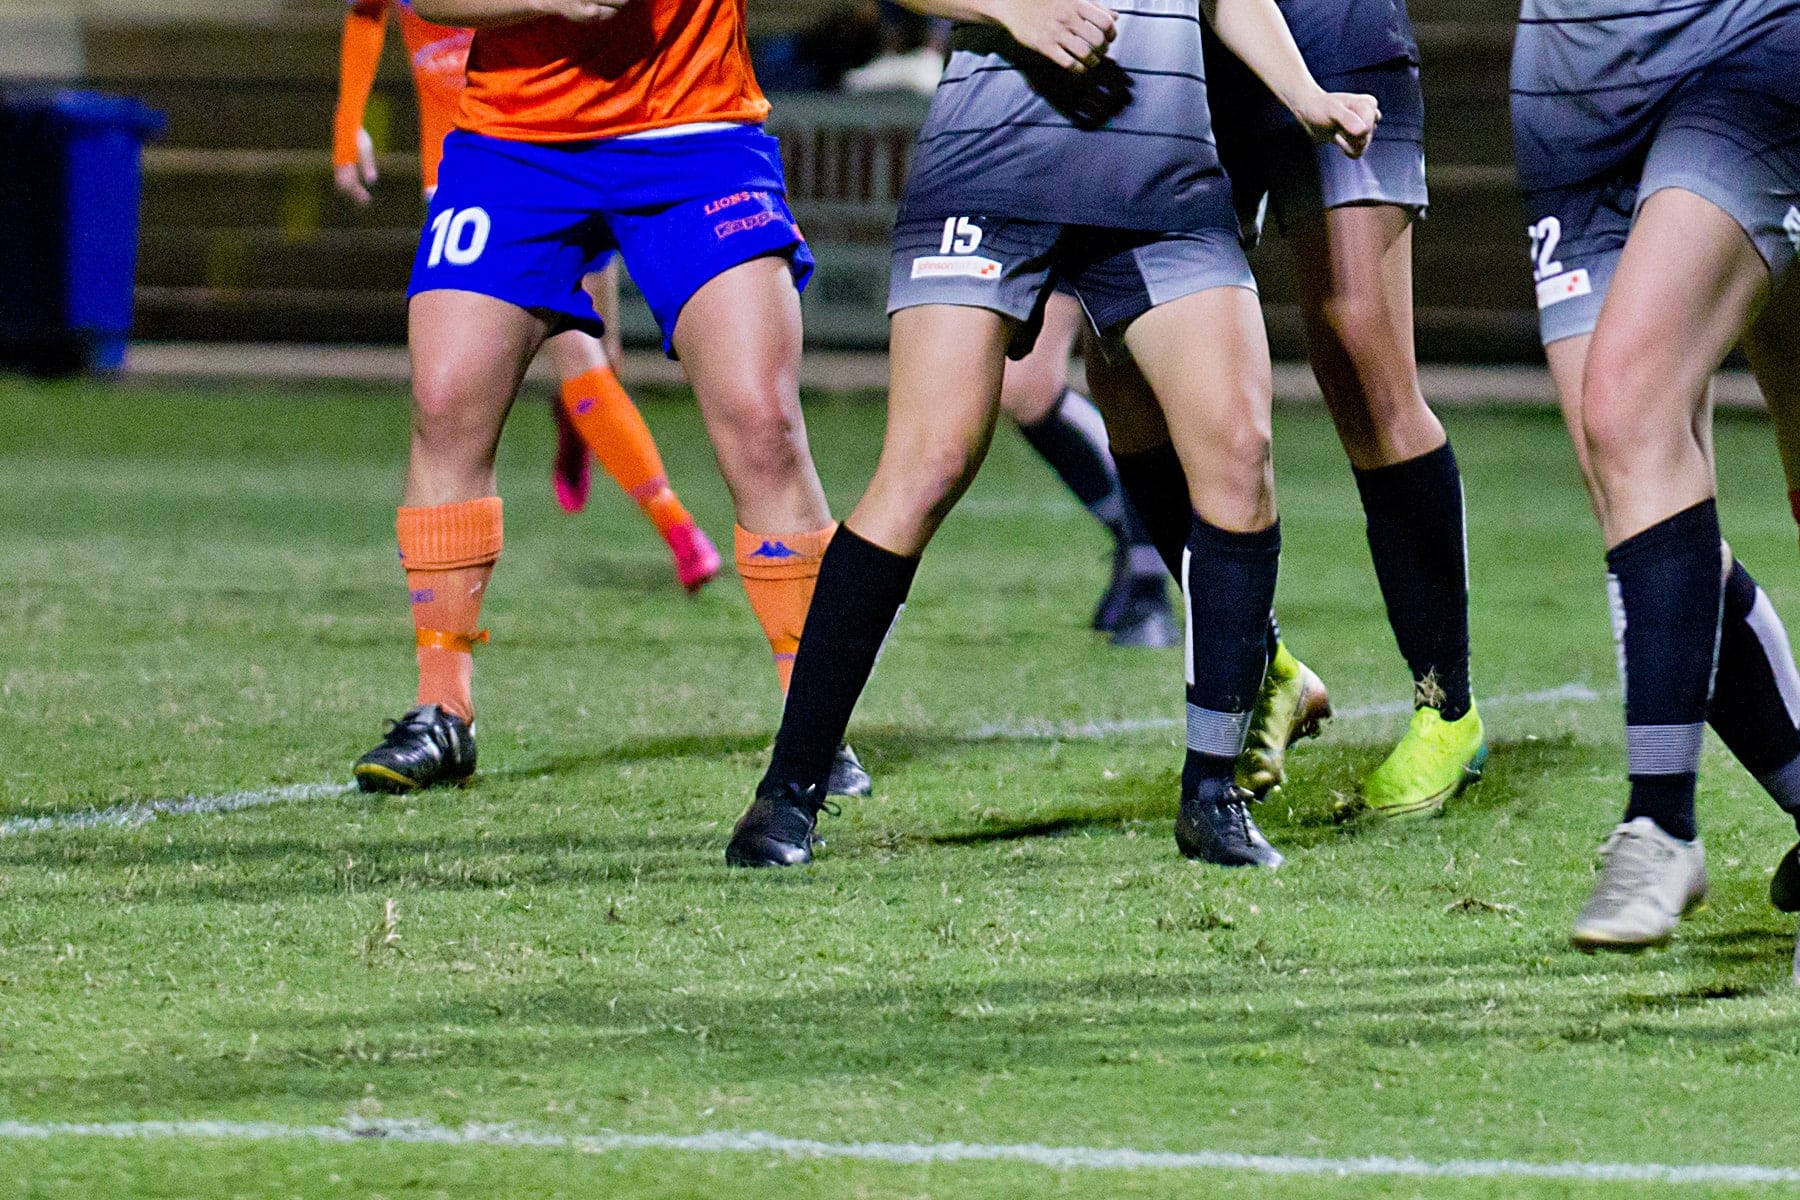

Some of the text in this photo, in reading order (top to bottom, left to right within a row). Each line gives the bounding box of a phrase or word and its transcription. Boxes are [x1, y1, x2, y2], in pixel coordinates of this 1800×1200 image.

[704, 191, 750, 215] LIONS
[427, 206, 491, 268] 10
[939, 216, 984, 255] 15
